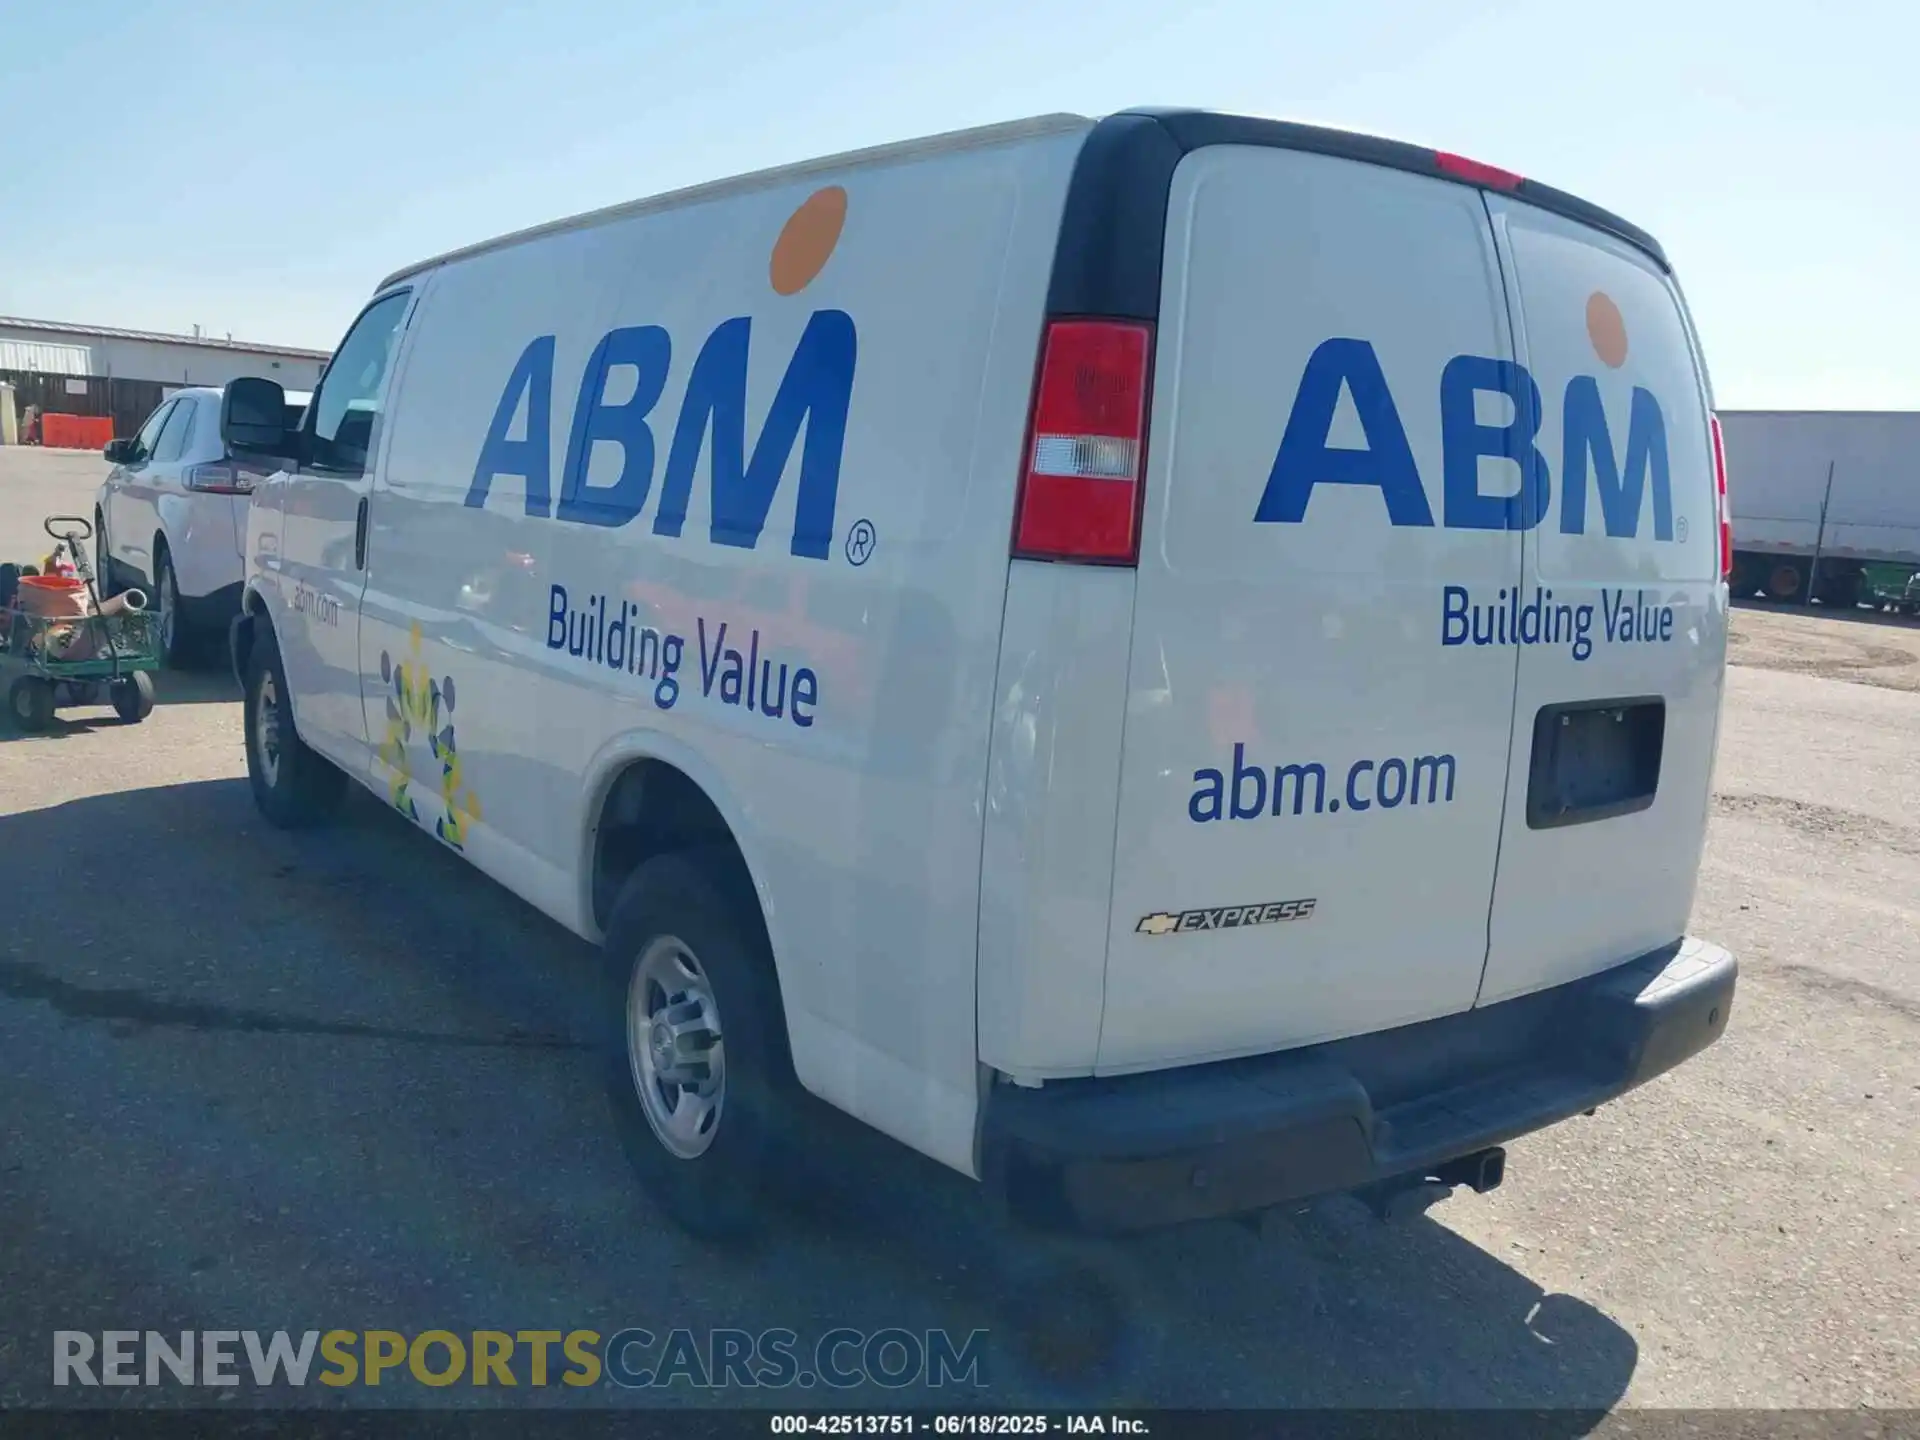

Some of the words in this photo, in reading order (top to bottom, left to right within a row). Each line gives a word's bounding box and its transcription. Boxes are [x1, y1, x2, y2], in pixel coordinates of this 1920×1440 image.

[464, 309, 857, 561] ABM
[1254, 336, 1673, 541] ABM
[294, 578, 338, 628] abm.com
[1441, 585, 1594, 661] Building
[1602, 589, 1674, 643] Value
[547, 584, 684, 710] Building
[697, 616, 818, 728] Value
[1187, 743, 1457, 823] abm.com
[1174, 899, 1316, 931] EXPRESS
